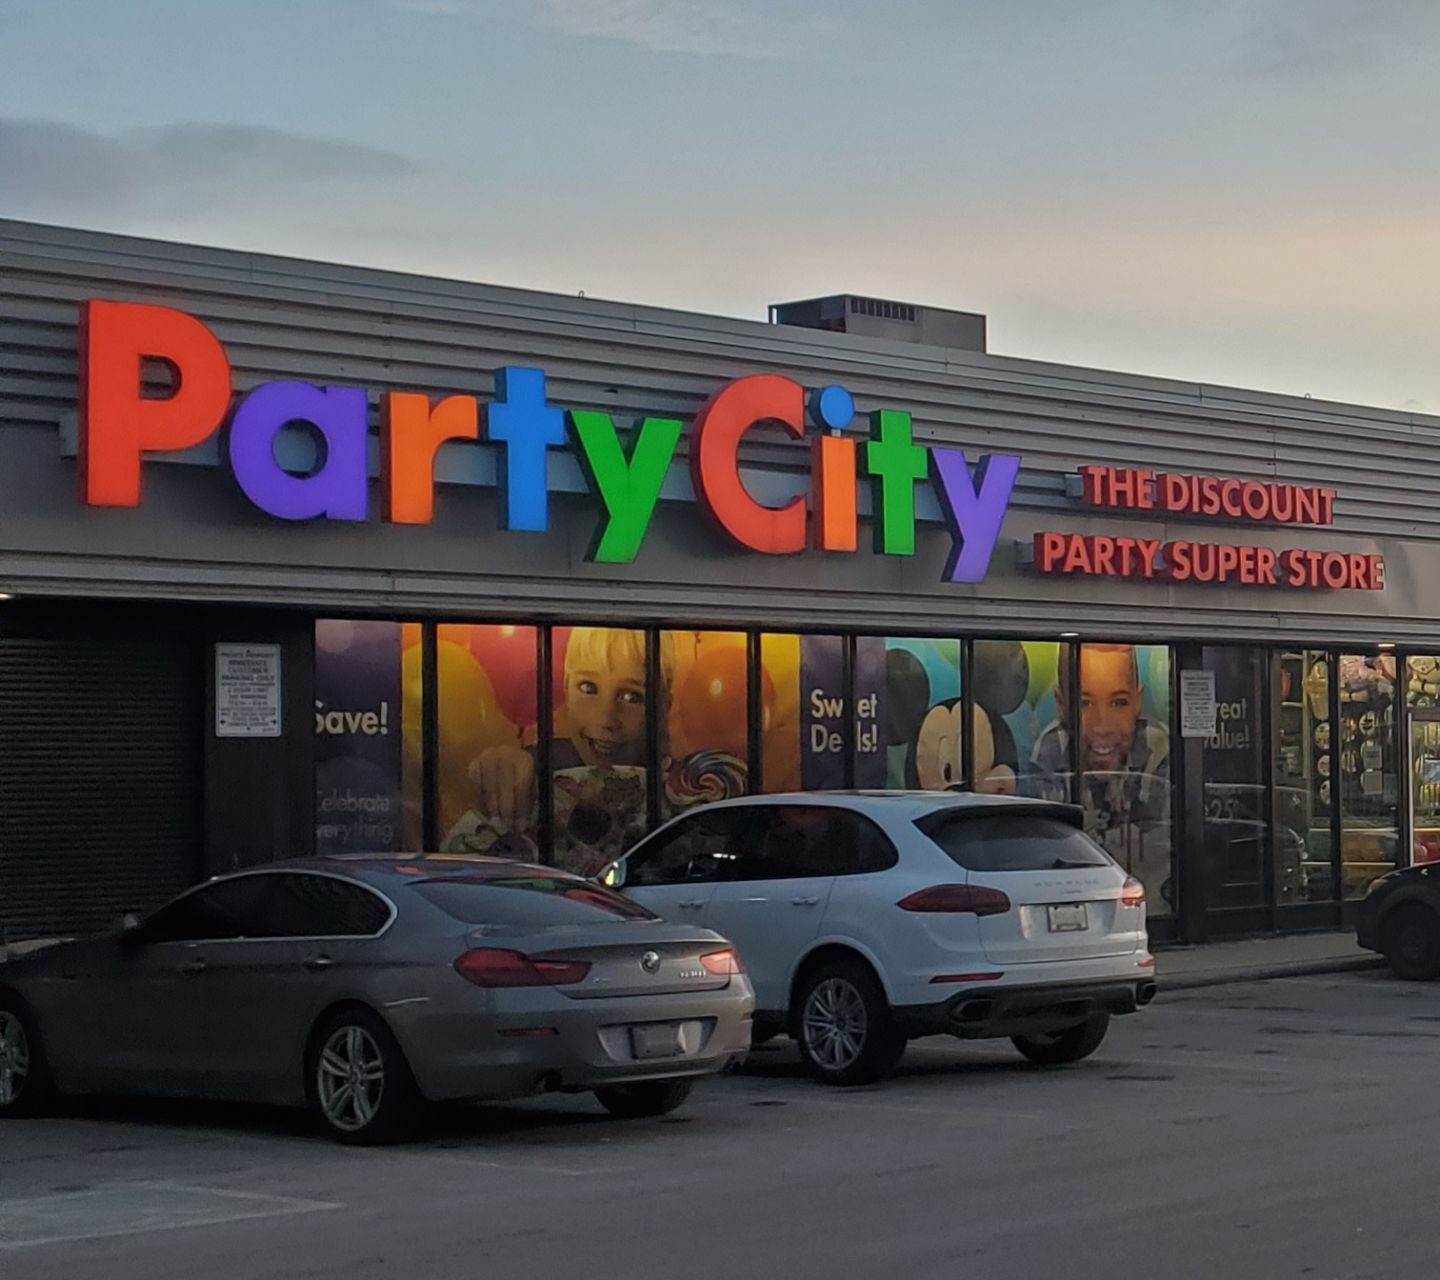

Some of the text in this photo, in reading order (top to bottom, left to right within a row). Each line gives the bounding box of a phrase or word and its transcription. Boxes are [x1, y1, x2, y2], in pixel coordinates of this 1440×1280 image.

[1083, 465, 1336, 525] THE DISCOUNT
[1036, 532, 1384, 590] PARTY SUPER STORE
[811, 689, 878, 718] Swet
[1213, 697, 1248, 720] reat
[811, 721, 878, 753] Dels!
[317, 787, 391, 812] elebrate
